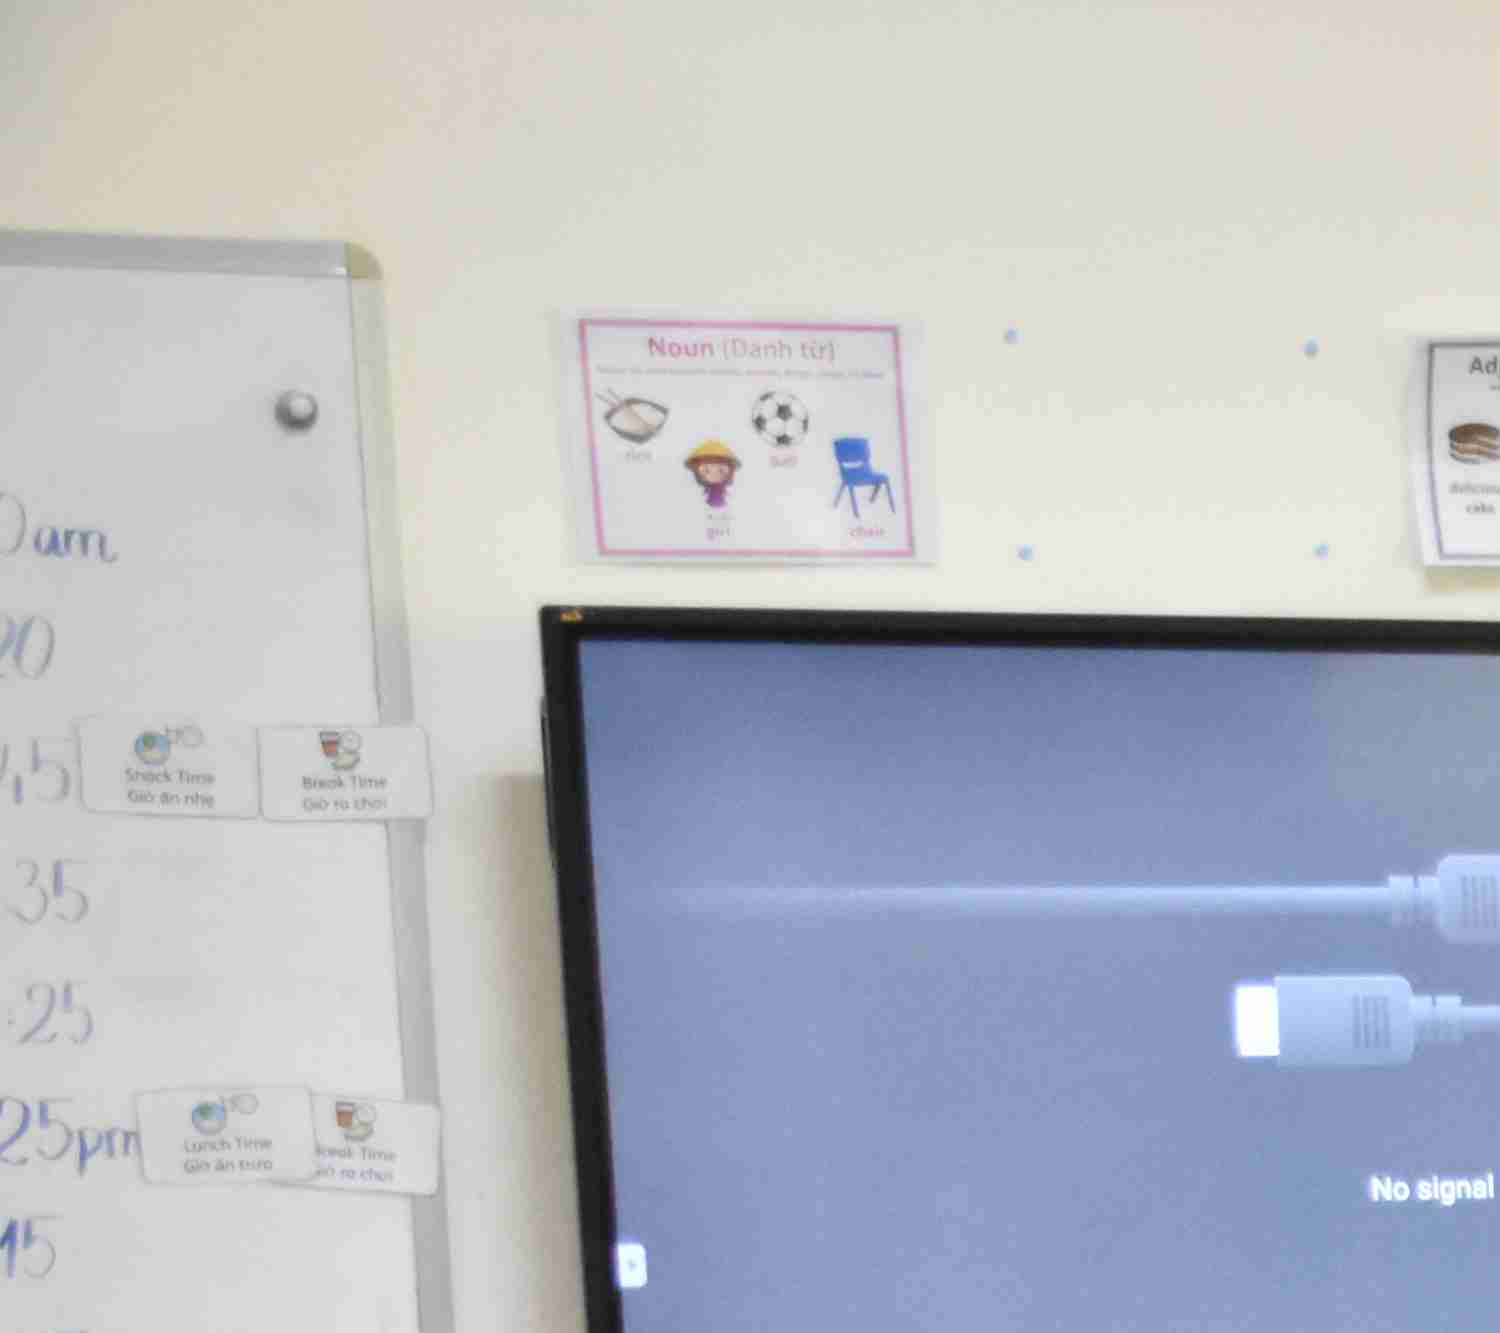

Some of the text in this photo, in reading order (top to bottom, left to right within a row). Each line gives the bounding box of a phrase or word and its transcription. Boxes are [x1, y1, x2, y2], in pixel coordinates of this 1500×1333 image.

[647, 336, 716, 360] Noun
[1370, 1172, 1495, 1206] No signal
